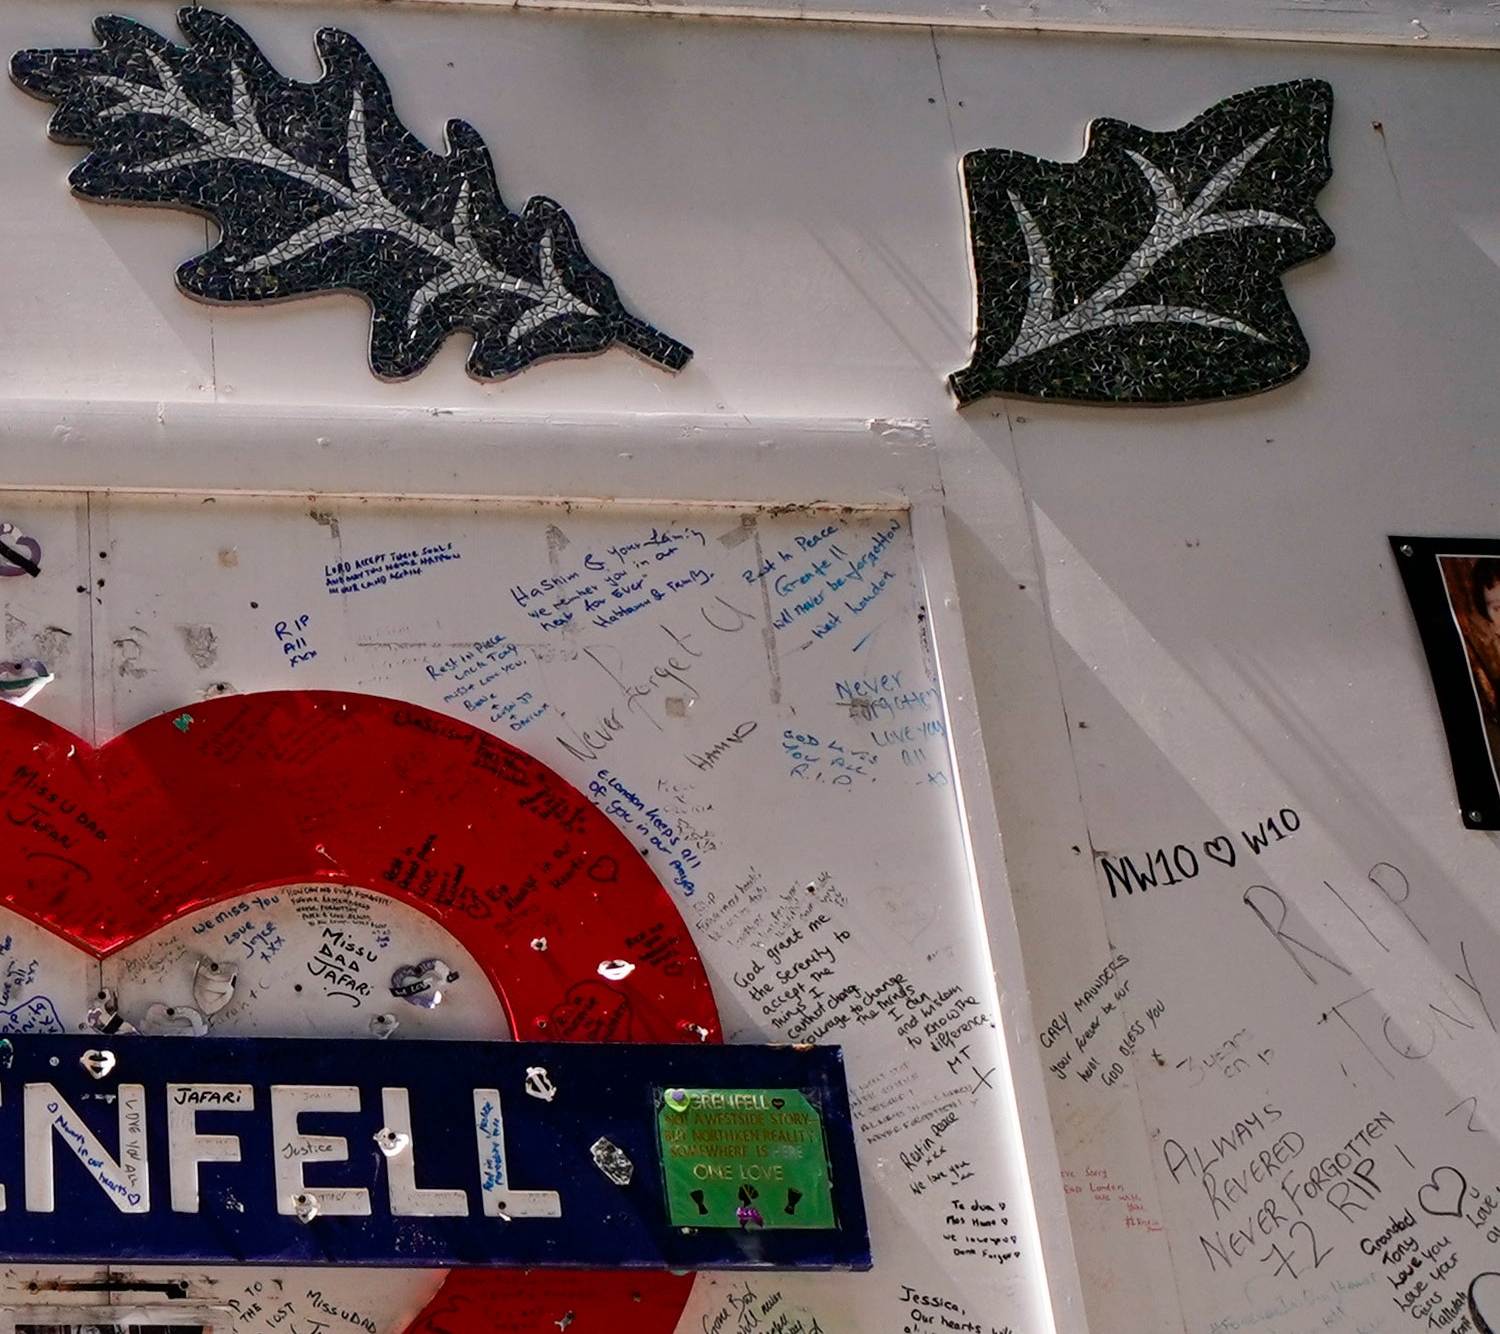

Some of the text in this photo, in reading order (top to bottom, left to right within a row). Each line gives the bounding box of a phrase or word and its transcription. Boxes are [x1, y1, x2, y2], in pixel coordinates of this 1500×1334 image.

[1101, 807, 1301, 898] NW10 W10
[693, 1164, 783, 1180] ONE LOVE
